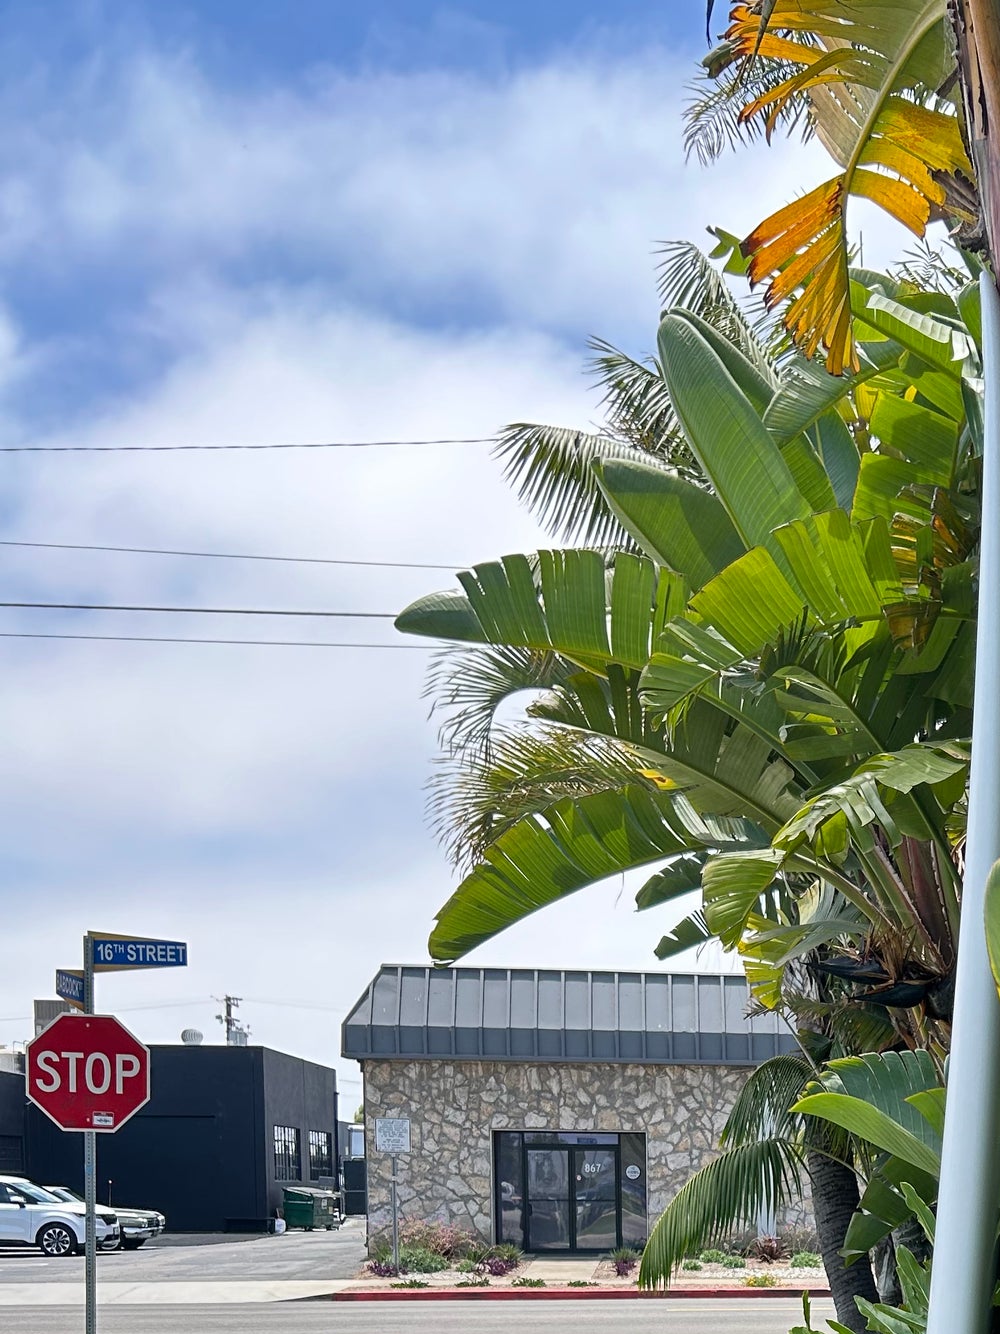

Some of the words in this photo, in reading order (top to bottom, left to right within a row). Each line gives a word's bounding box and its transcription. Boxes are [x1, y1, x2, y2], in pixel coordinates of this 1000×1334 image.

[97, 943, 125, 961] 16TH
[126, 944, 186, 962] STREET
[35, 1050, 141, 1095] STOP
[584, 1163, 601, 1173] 867
